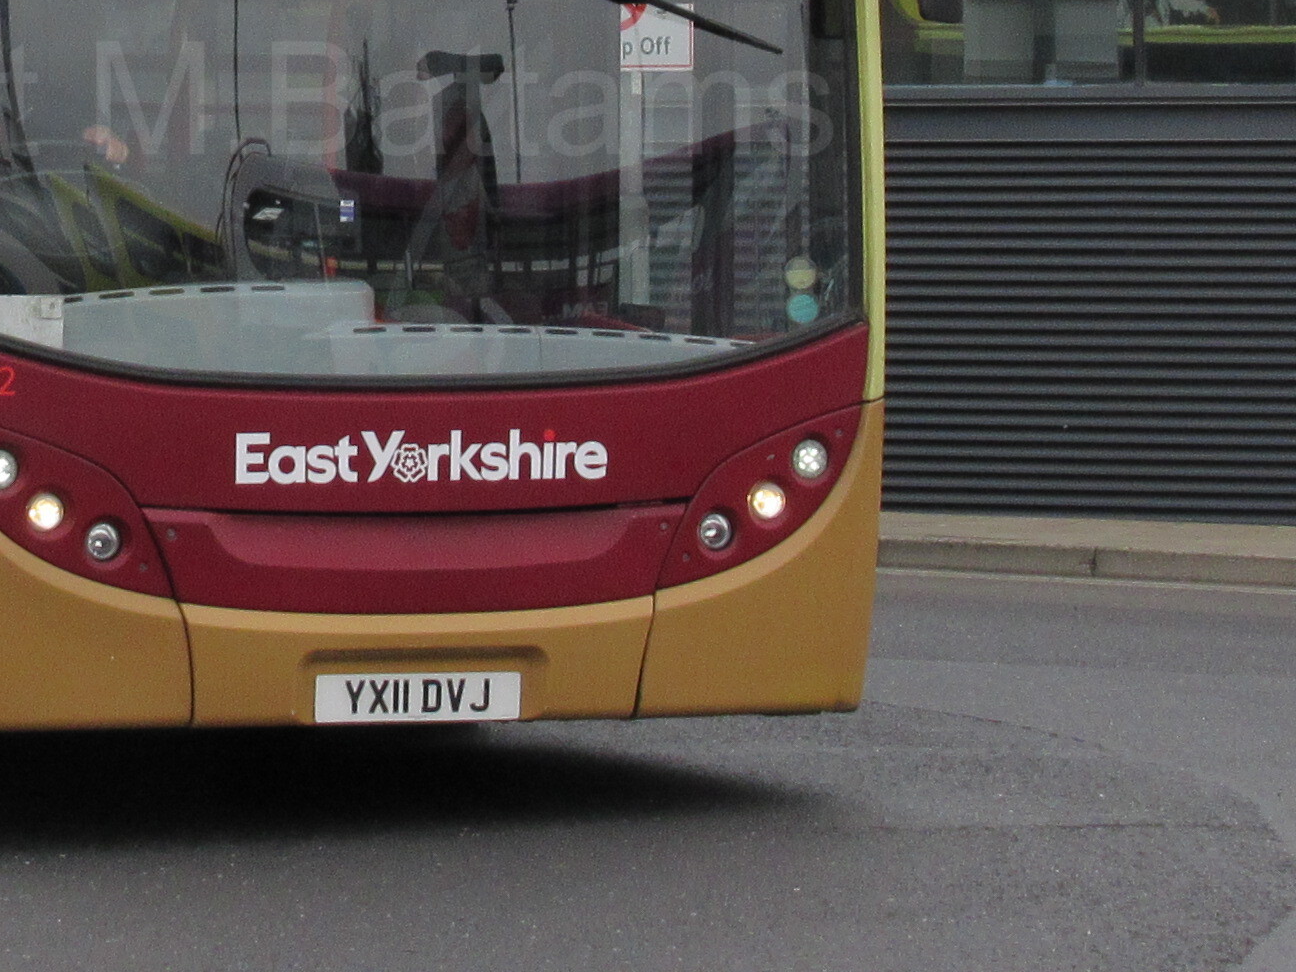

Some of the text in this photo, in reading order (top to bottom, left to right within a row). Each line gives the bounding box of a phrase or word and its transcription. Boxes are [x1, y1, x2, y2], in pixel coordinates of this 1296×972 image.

[640, 36, 672, 55] Off
[235, 428, 609, 485] East Yorkshire
[421, 678, 491, 714] DVJ
